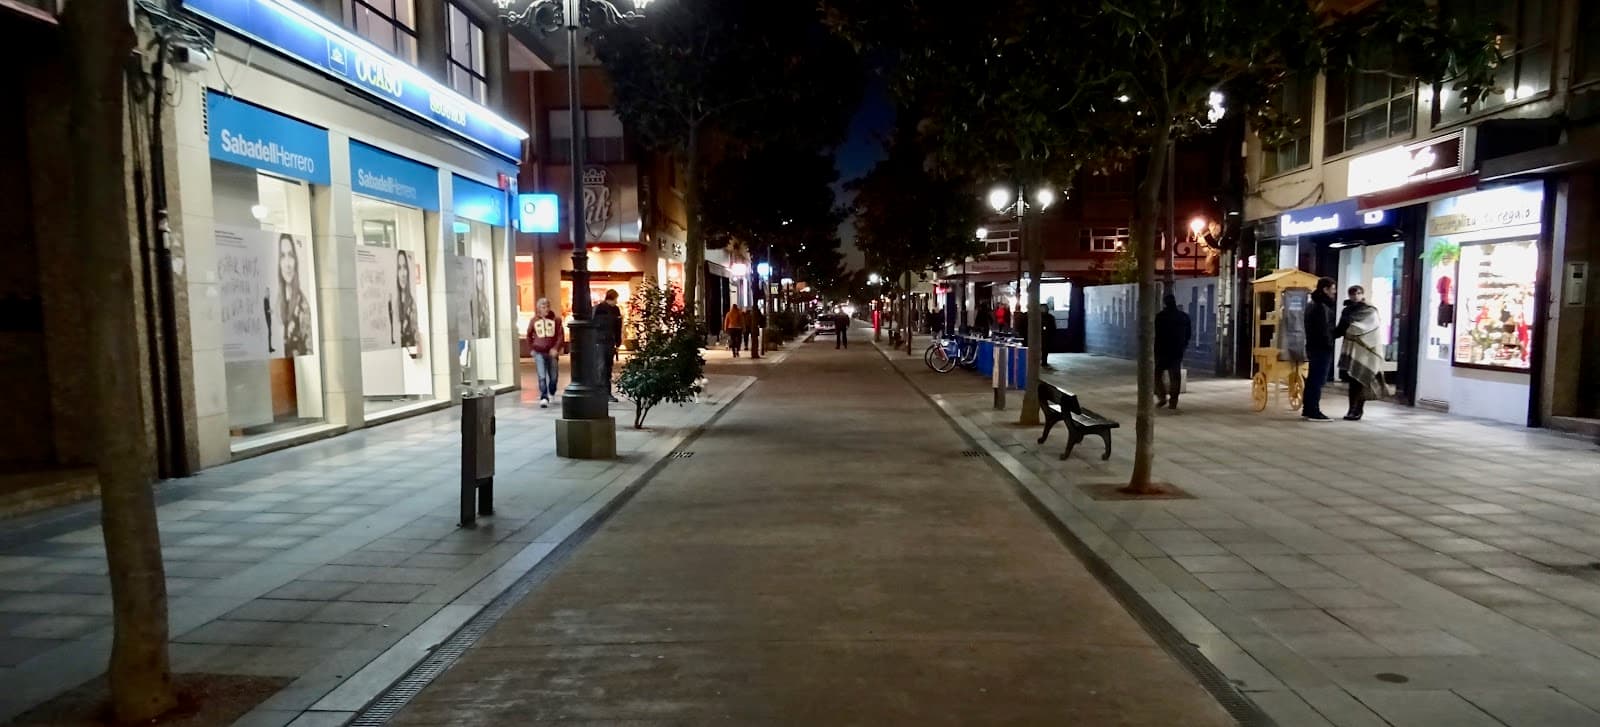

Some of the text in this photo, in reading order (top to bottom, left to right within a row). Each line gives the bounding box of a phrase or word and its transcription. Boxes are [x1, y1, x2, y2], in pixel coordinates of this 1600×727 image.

[355, 54, 402, 98] OCASO
[221, 128, 315, 174] SabadellHerrero
[358, 167, 417, 200] SabadellHerrero
